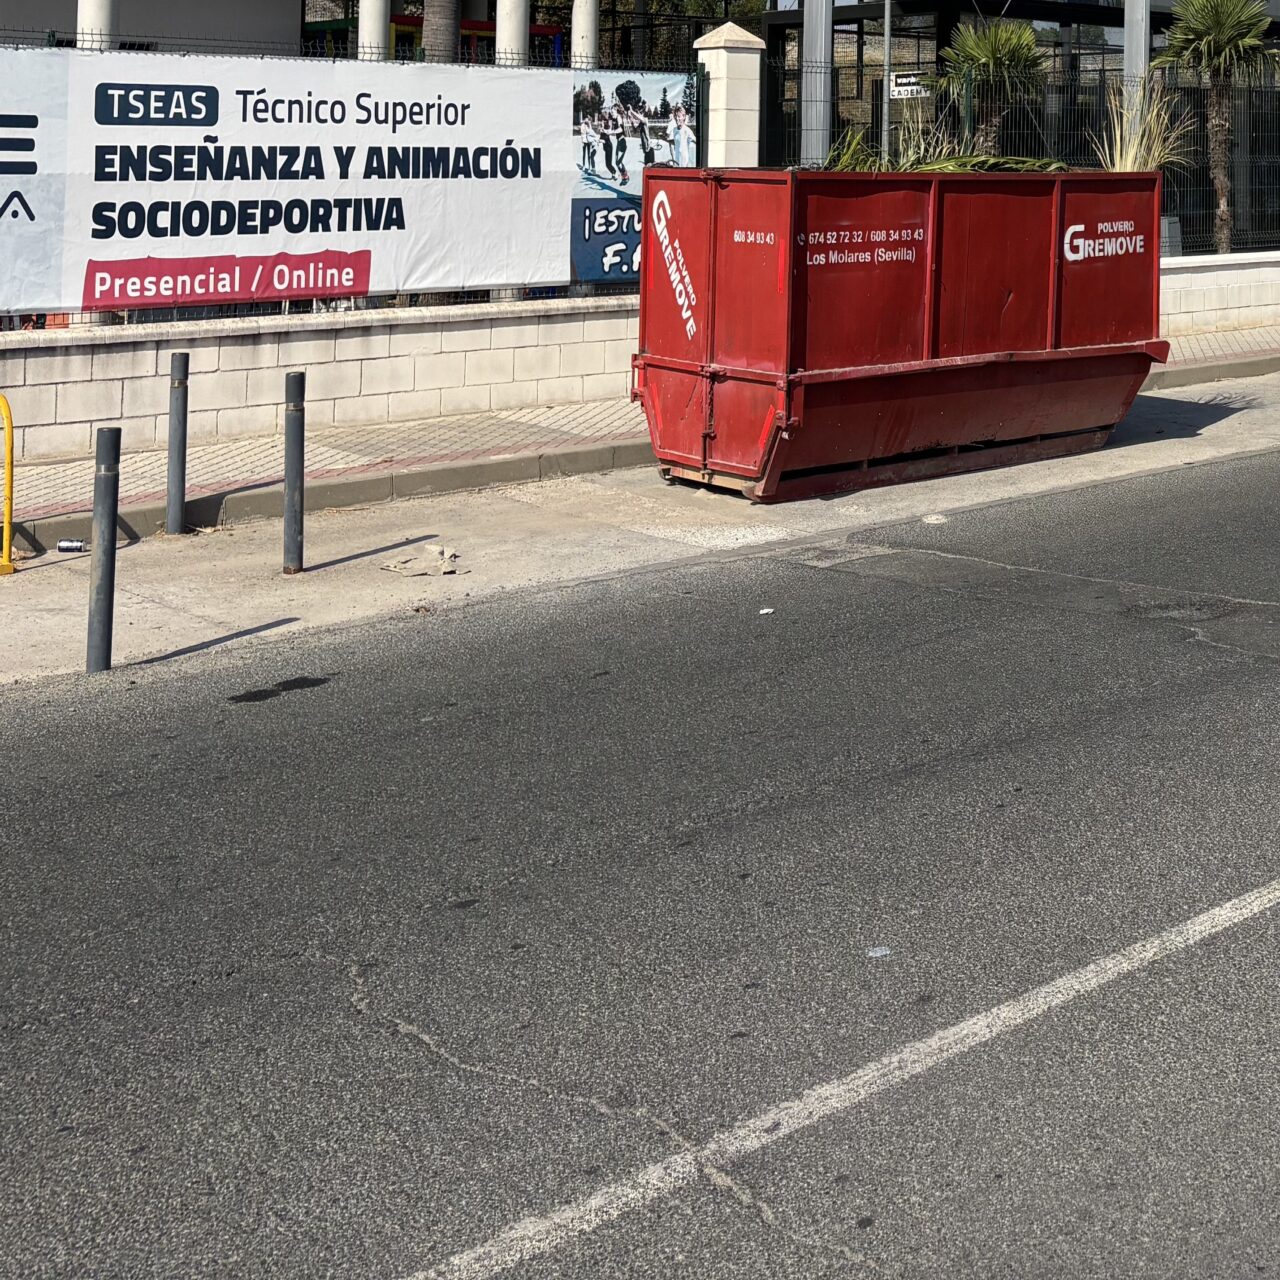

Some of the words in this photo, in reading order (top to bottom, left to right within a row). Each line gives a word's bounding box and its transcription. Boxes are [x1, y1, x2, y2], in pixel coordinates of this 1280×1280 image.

[891, 87, 929, 97] CADEMY
[107, 89, 207, 119] TSEAS
[236, 88, 346, 124] Técnico
[355, 93, 471, 133] Superior
[94, 135, 325, 181] ENSEÑANZA
[333, 146, 356, 180] Y
[363, 139, 542, 180] ANIMACIÓN
[91, 197, 406, 239] SOCIODEPORTIVA
[1097, 220, 1134, 234] POLVERO
[733, 230, 745, 243] 608
[747, 230, 755, 243] 34
[756, 232, 764, 244] 93
[765, 232, 775, 245] 43
[809, 232, 825, 245] 674
[826, 232, 837, 244] 52
[839, 231, 850, 243] 72
[852, 231, 863, 243] 32
[870, 230, 887, 242] 608
[888, 229, 900, 241] 34
[901, 229, 912, 240] 93
[913, 228, 924, 240] 43
[1064, 224, 1144, 261] GREMOVE
[652, 190, 697, 341] GREMOVE
[673, 238, 697, 306] POLVERO
[806, 251, 826, 265] Los
[828, 249, 871, 264] Molares
[874, 247, 916, 265] (Sevilla)
[94, 266, 241, 299] Presencial
[251, 264, 263, 291] /
[273, 263, 354, 289] Online
